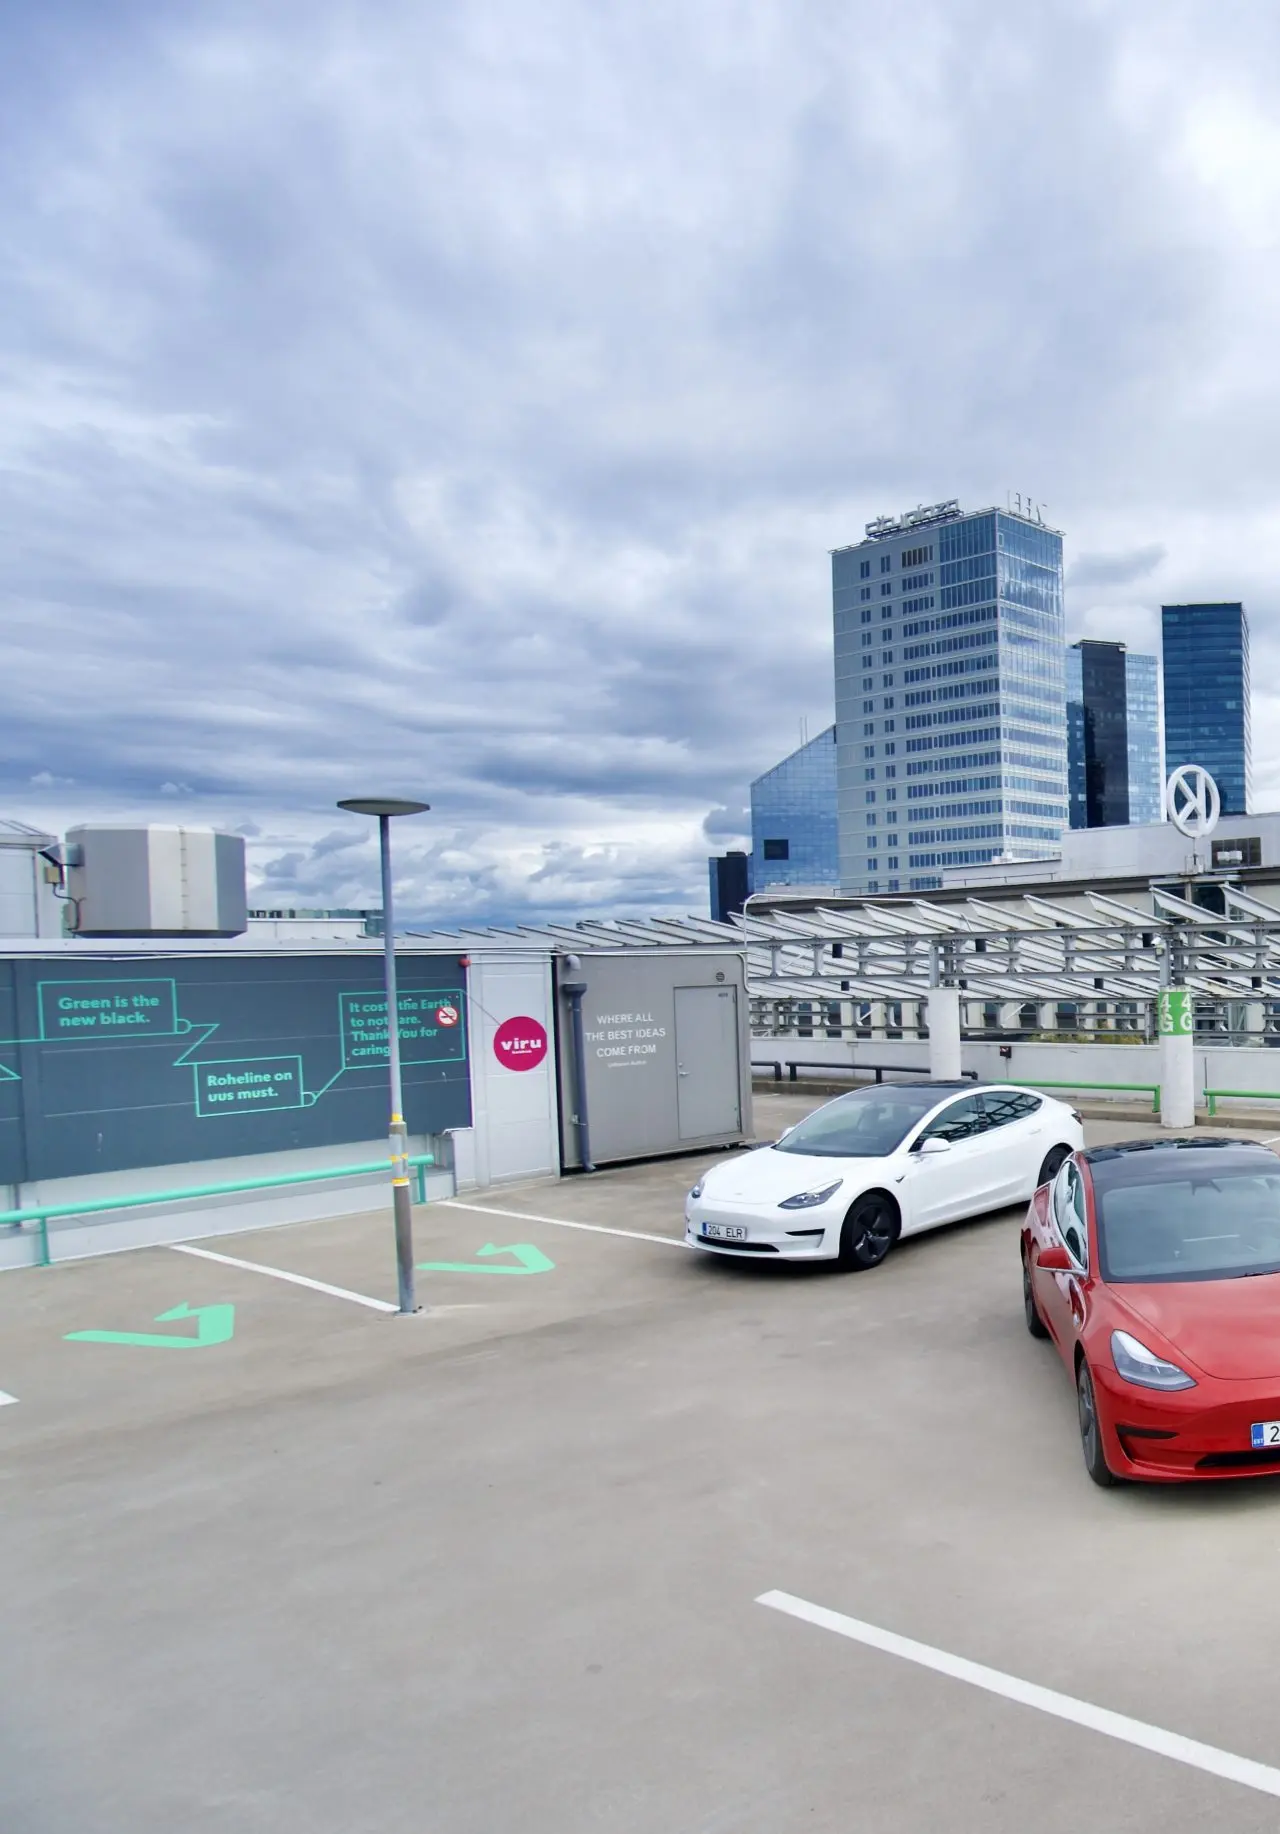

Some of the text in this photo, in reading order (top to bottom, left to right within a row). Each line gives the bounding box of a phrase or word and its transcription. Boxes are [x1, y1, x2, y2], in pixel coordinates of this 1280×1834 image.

[59, 994, 160, 1010] Green is the
[349, 998, 452, 1012] It cost the Earth
[1181, 992, 1192, 1012] 4
[60, 1012, 151, 1026] new black.
[350, 1016, 422, 1027] to not are.
[596, 1011, 655, 1025] WHERE ALL
[1160, 1013, 1174, 1033] G
[1180, 1011, 1192, 1031] G
[351, 1029, 391, 1042] Thank
[420, 1027, 438, 1037] for
[585, 1028, 666, 1041] THE BEST IDEAS
[501, 1037, 541, 1050] viru
[596, 1044, 656, 1057] COME FROM
[207, 1071, 293, 1086] Roheline on
[208, 1086, 279, 1102] uus must.
[708, 1225, 743, 1239] 204 ELR
